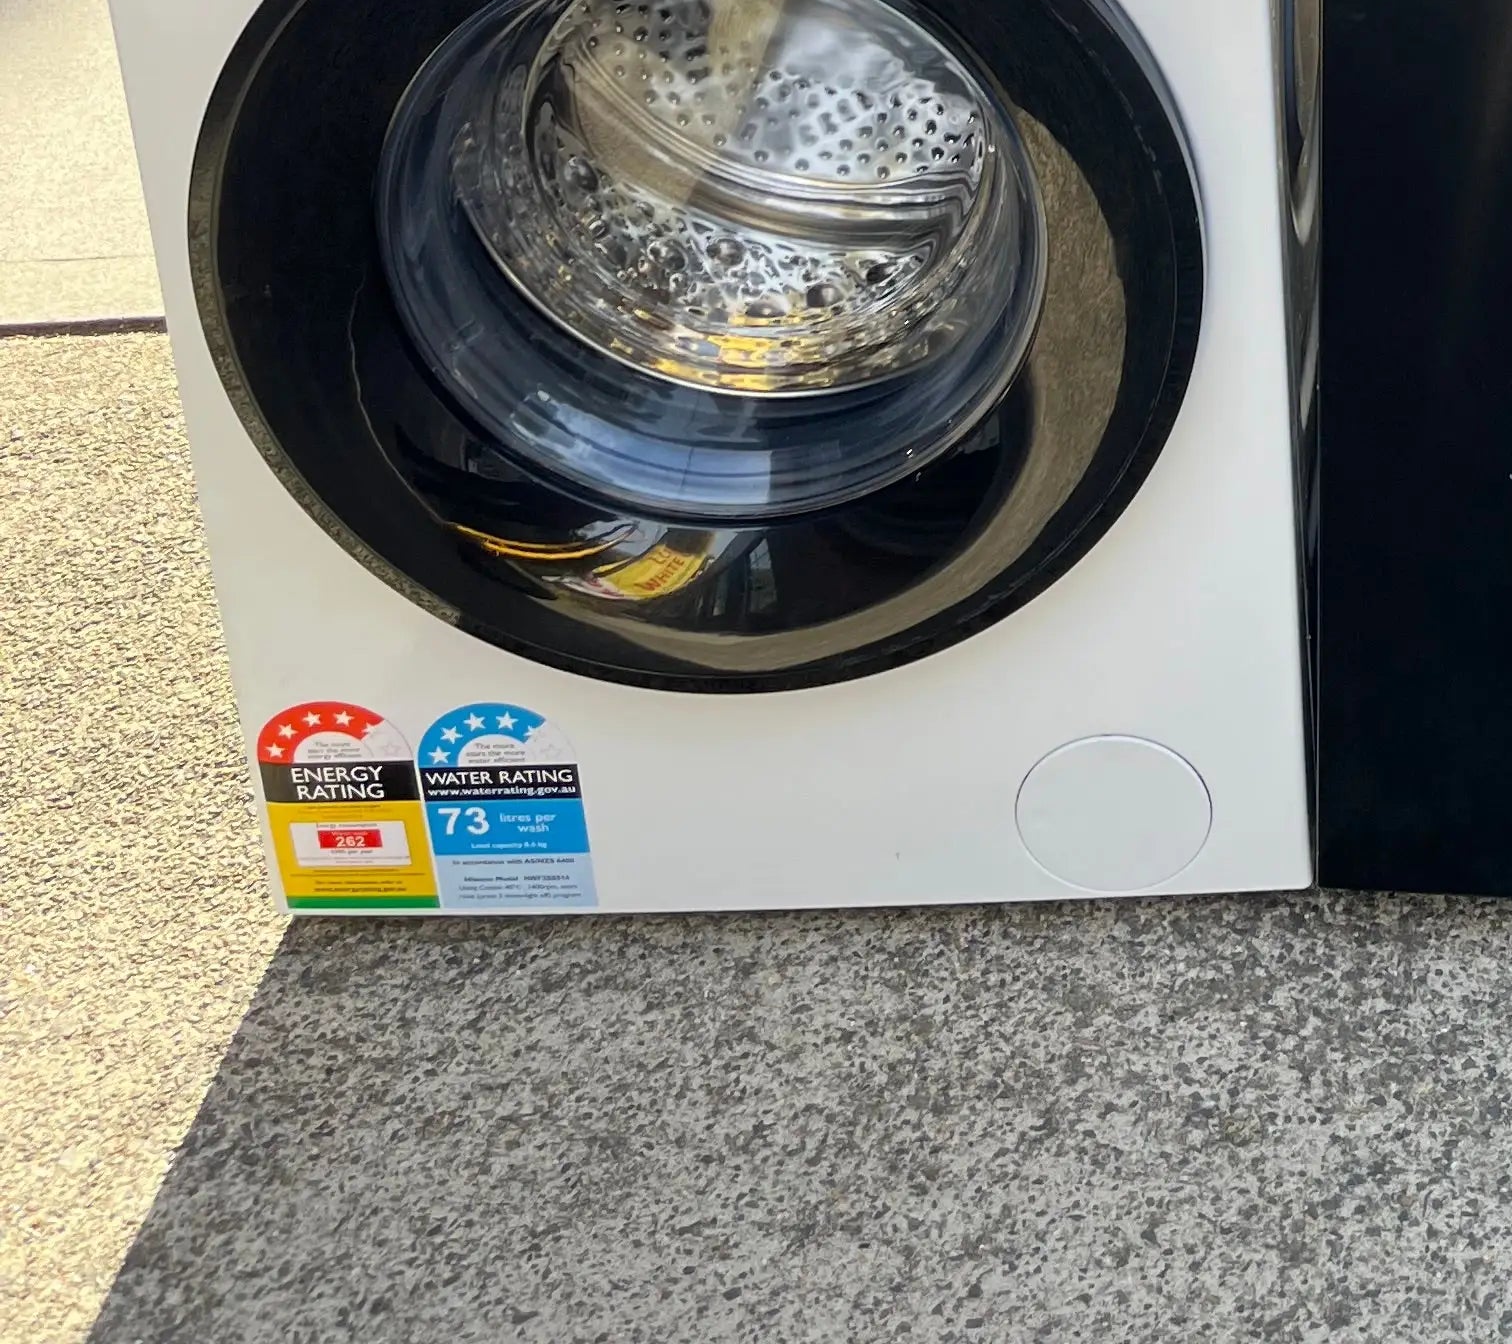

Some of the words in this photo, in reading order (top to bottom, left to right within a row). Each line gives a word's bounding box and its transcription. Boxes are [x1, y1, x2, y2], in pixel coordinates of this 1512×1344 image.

[291, 766, 383, 783] ENERGY
[425, 770, 494, 786] WATER
[498, 769, 573, 784] RATING
[296, 783, 385, 801] RATING
[427, 785, 577, 797] www.waterrating.gov.au
[437, 806, 490, 836] 73
[500, 812, 531, 822] litres
[535, 813, 557, 824] per
[517, 823, 550, 833] wash
[335, 835, 366, 847] 262
